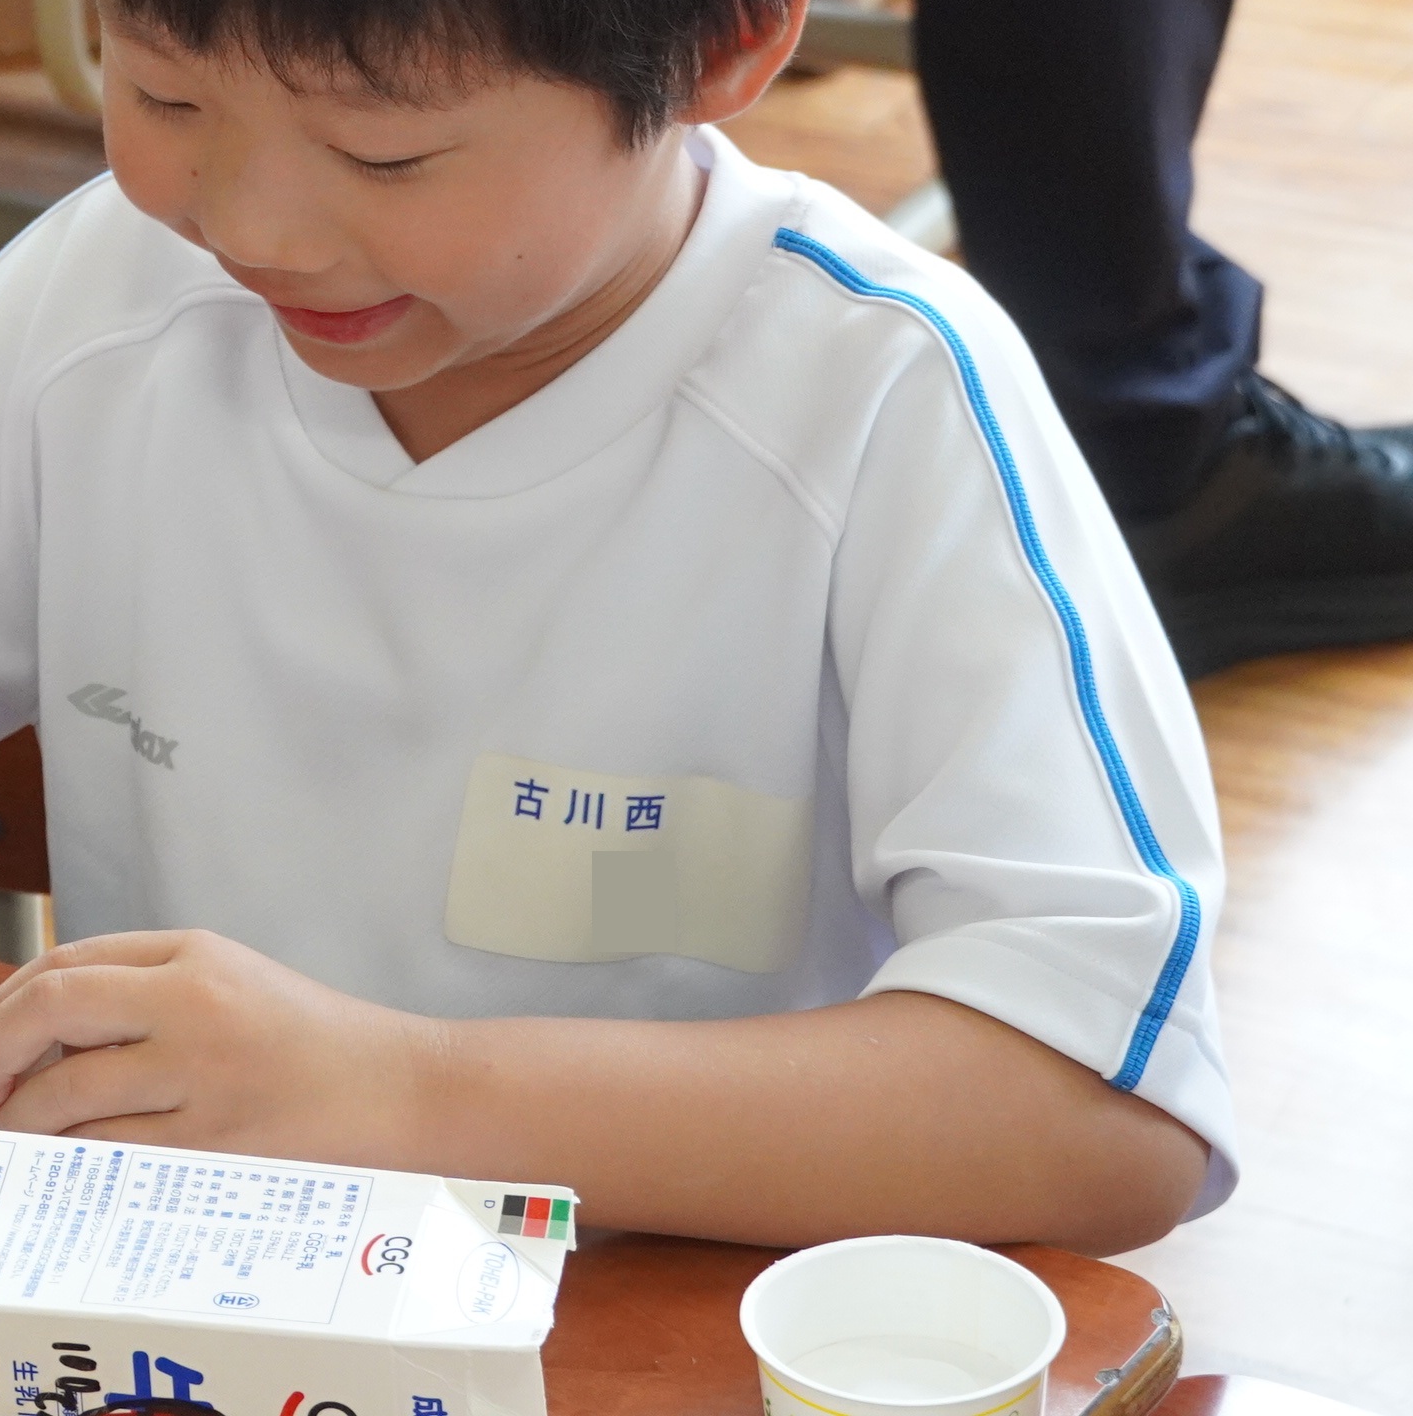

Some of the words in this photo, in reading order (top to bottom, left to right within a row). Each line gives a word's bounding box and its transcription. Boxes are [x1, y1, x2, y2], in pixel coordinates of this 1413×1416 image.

[514, 778, 665, 832] 古川西
[21, 1149, 46, 1197] ホームページ
[33, 1151, 65, 1220] 0120-912-855
[311, 1181, 334, 1226] 商品名
[335, 1183, 358, 1227] 種類別名称
[483, 1199, 494, 1209] D
[295, 1232, 323, 1271] CGC牛乳
[324, 1234, 346, 1259] 牛乳
[375, 1235, 413, 1275] CGC
[471, 1252, 505, 1315] TOHEI-PAK
